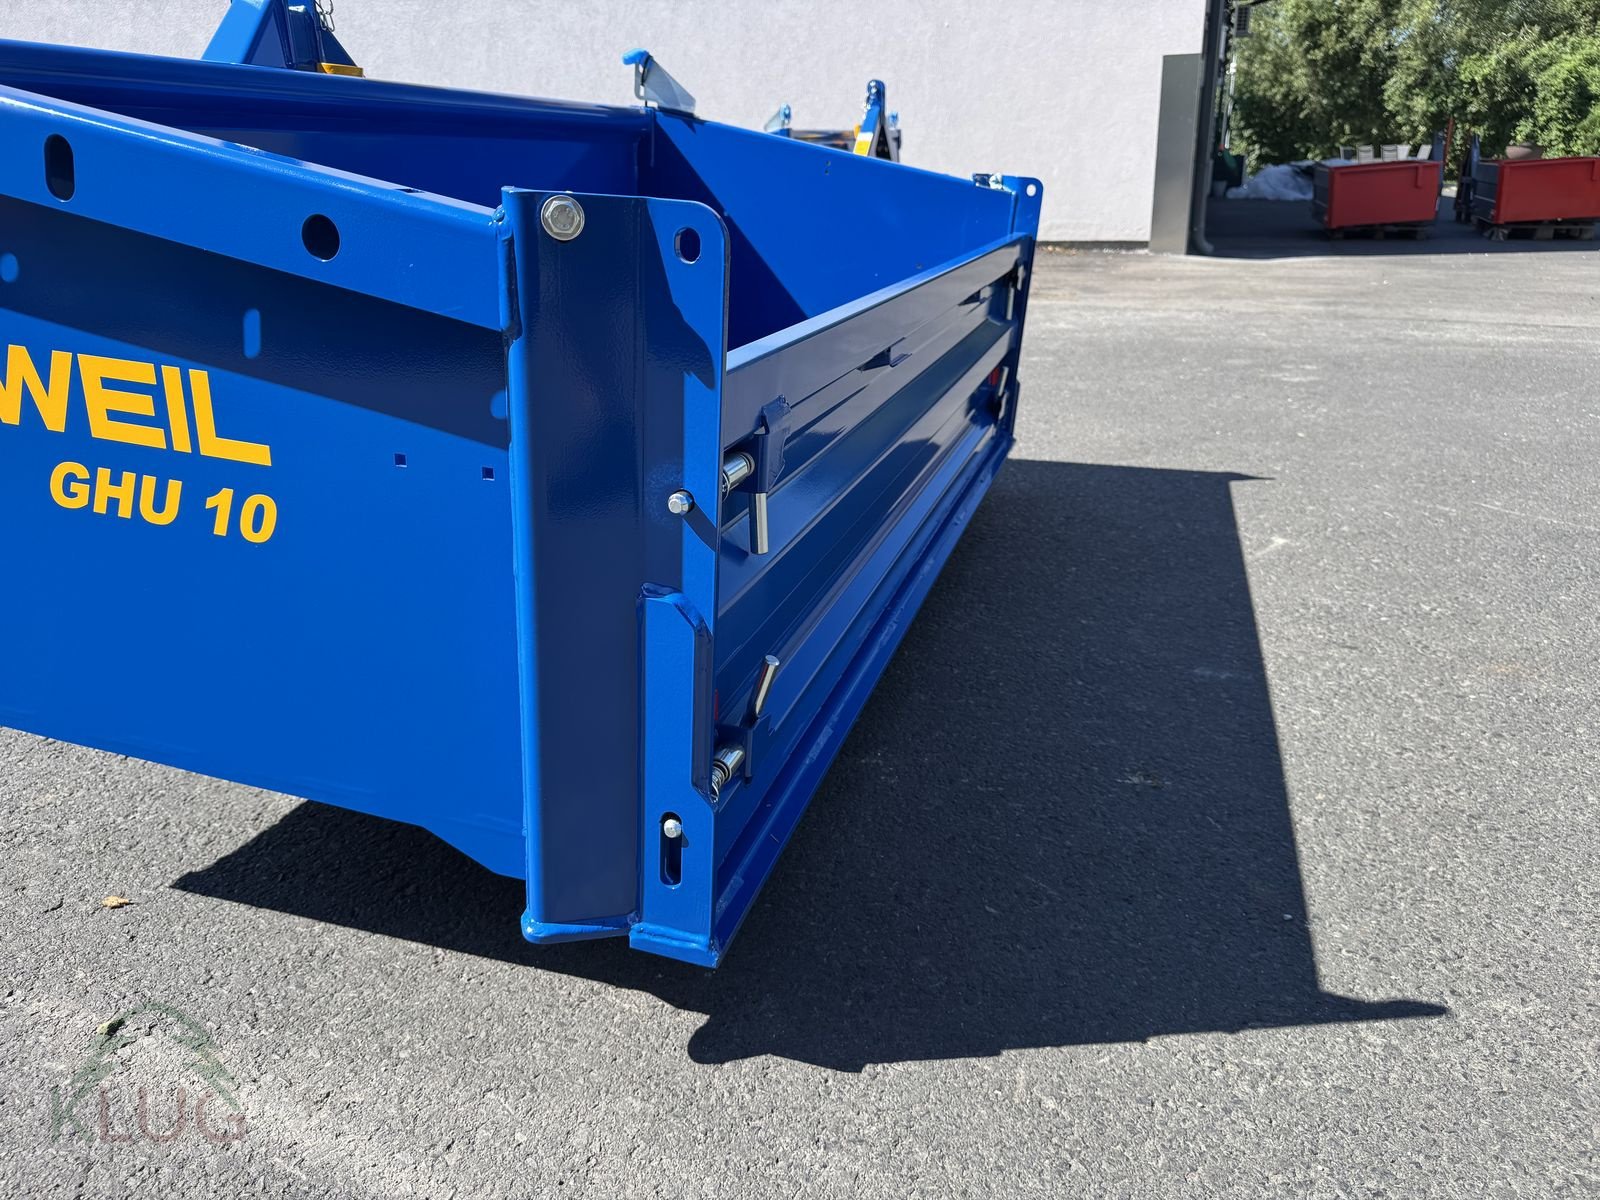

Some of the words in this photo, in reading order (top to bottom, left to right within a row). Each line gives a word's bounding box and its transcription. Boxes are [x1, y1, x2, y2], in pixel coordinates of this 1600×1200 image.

[0, 343, 272, 466] WEIL
[50, 461, 183, 526] GHU
[205, 487, 278, 543] 10
